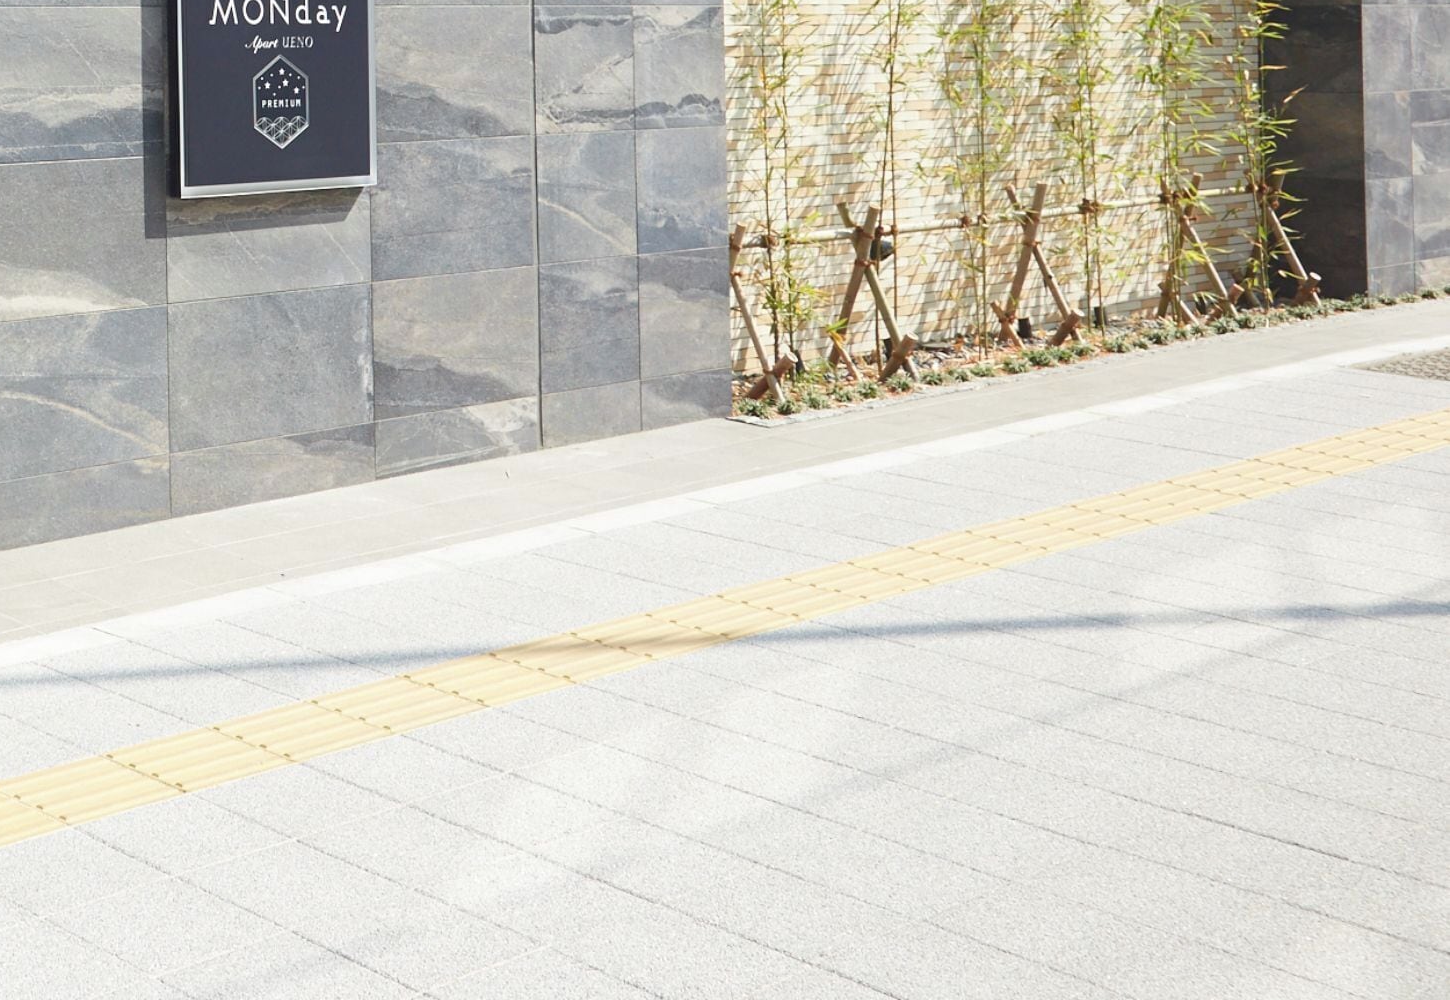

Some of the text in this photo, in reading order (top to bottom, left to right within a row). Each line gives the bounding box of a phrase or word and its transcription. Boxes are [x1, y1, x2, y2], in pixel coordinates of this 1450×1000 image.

[245, 35, 314, 54] Apart UENO
[261, 99, 302, 108] PREMIUM
